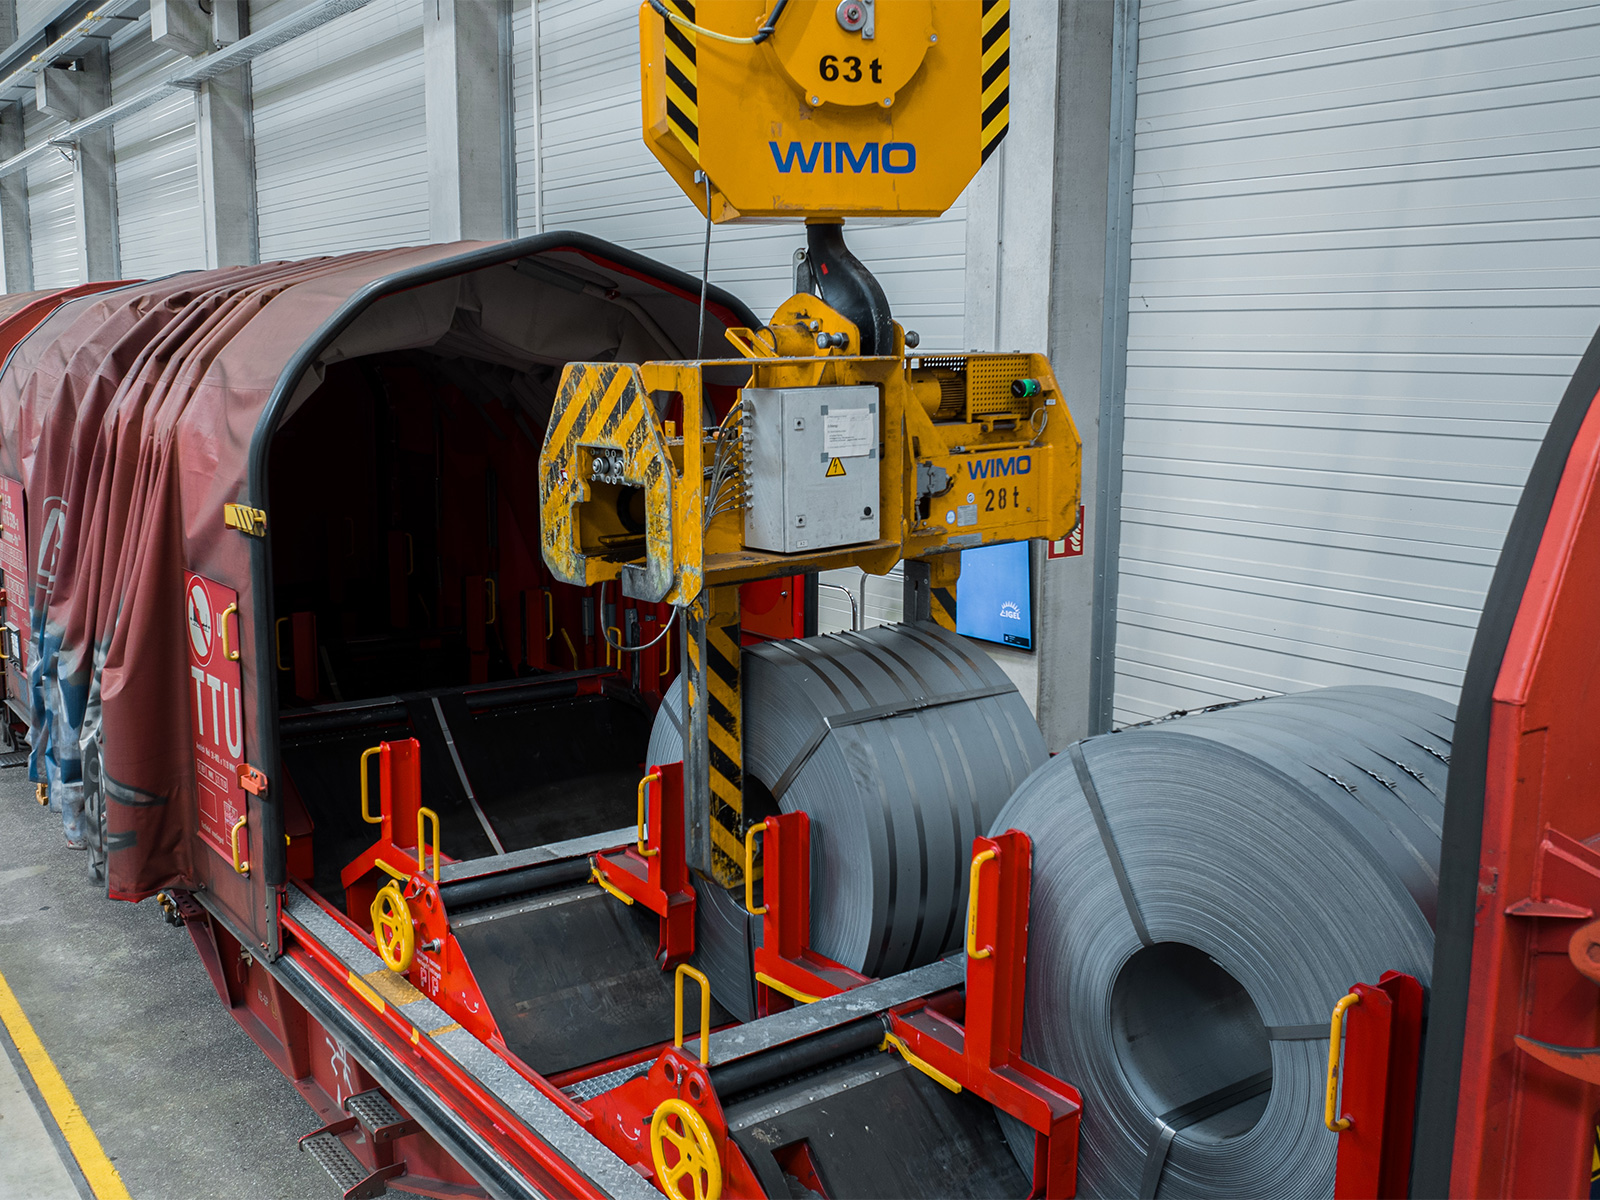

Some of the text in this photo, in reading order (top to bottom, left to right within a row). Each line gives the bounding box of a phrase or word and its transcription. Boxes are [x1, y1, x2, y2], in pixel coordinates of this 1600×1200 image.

[819, 55, 883, 84] 63 t
[768, 141, 917, 174] WIMO
[966, 455, 1031, 480] WIMO
[985, 486, 1019, 512] 28 t
[191, 665, 242, 759] TTU
